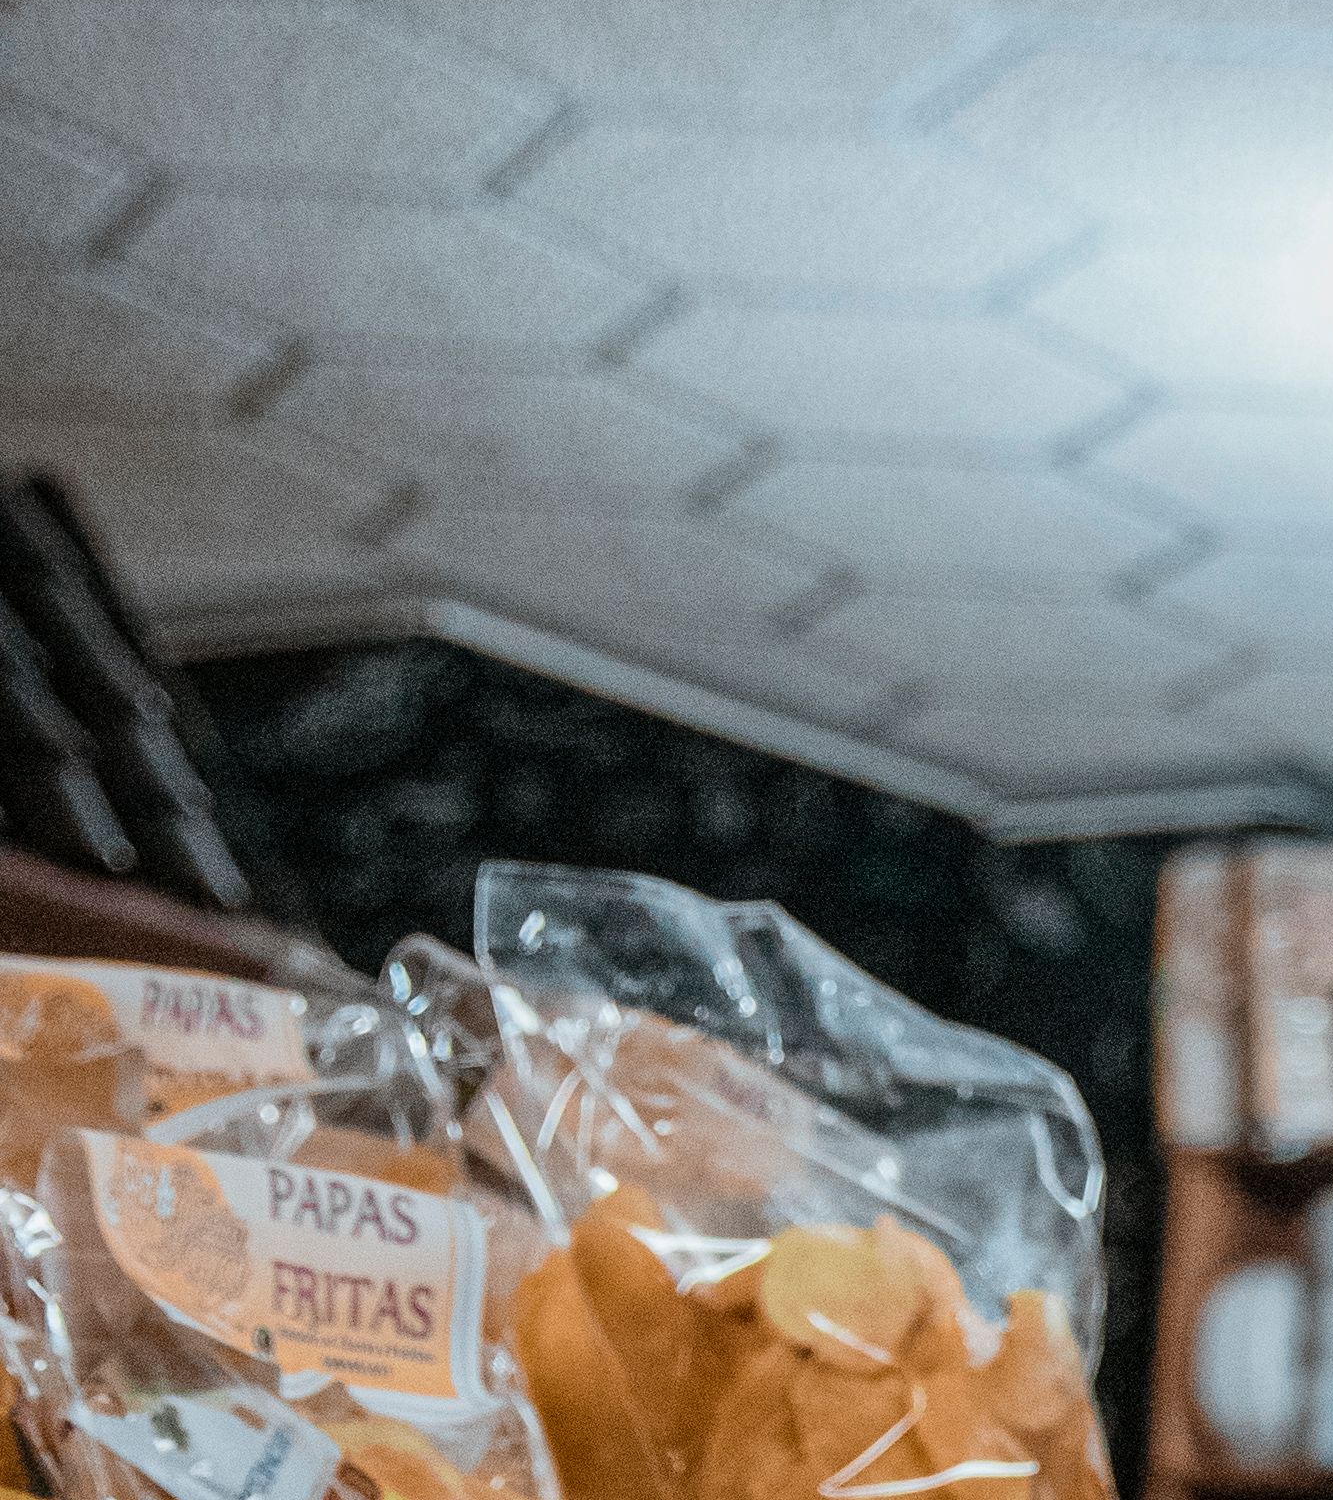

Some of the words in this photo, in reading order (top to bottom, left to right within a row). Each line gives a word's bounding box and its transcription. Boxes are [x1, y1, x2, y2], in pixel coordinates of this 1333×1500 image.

[140, 979, 265, 1040] PAPAS
[268, 1167, 418, 1245] PAPAS
[272, 1258, 436, 1338] FRITAS
